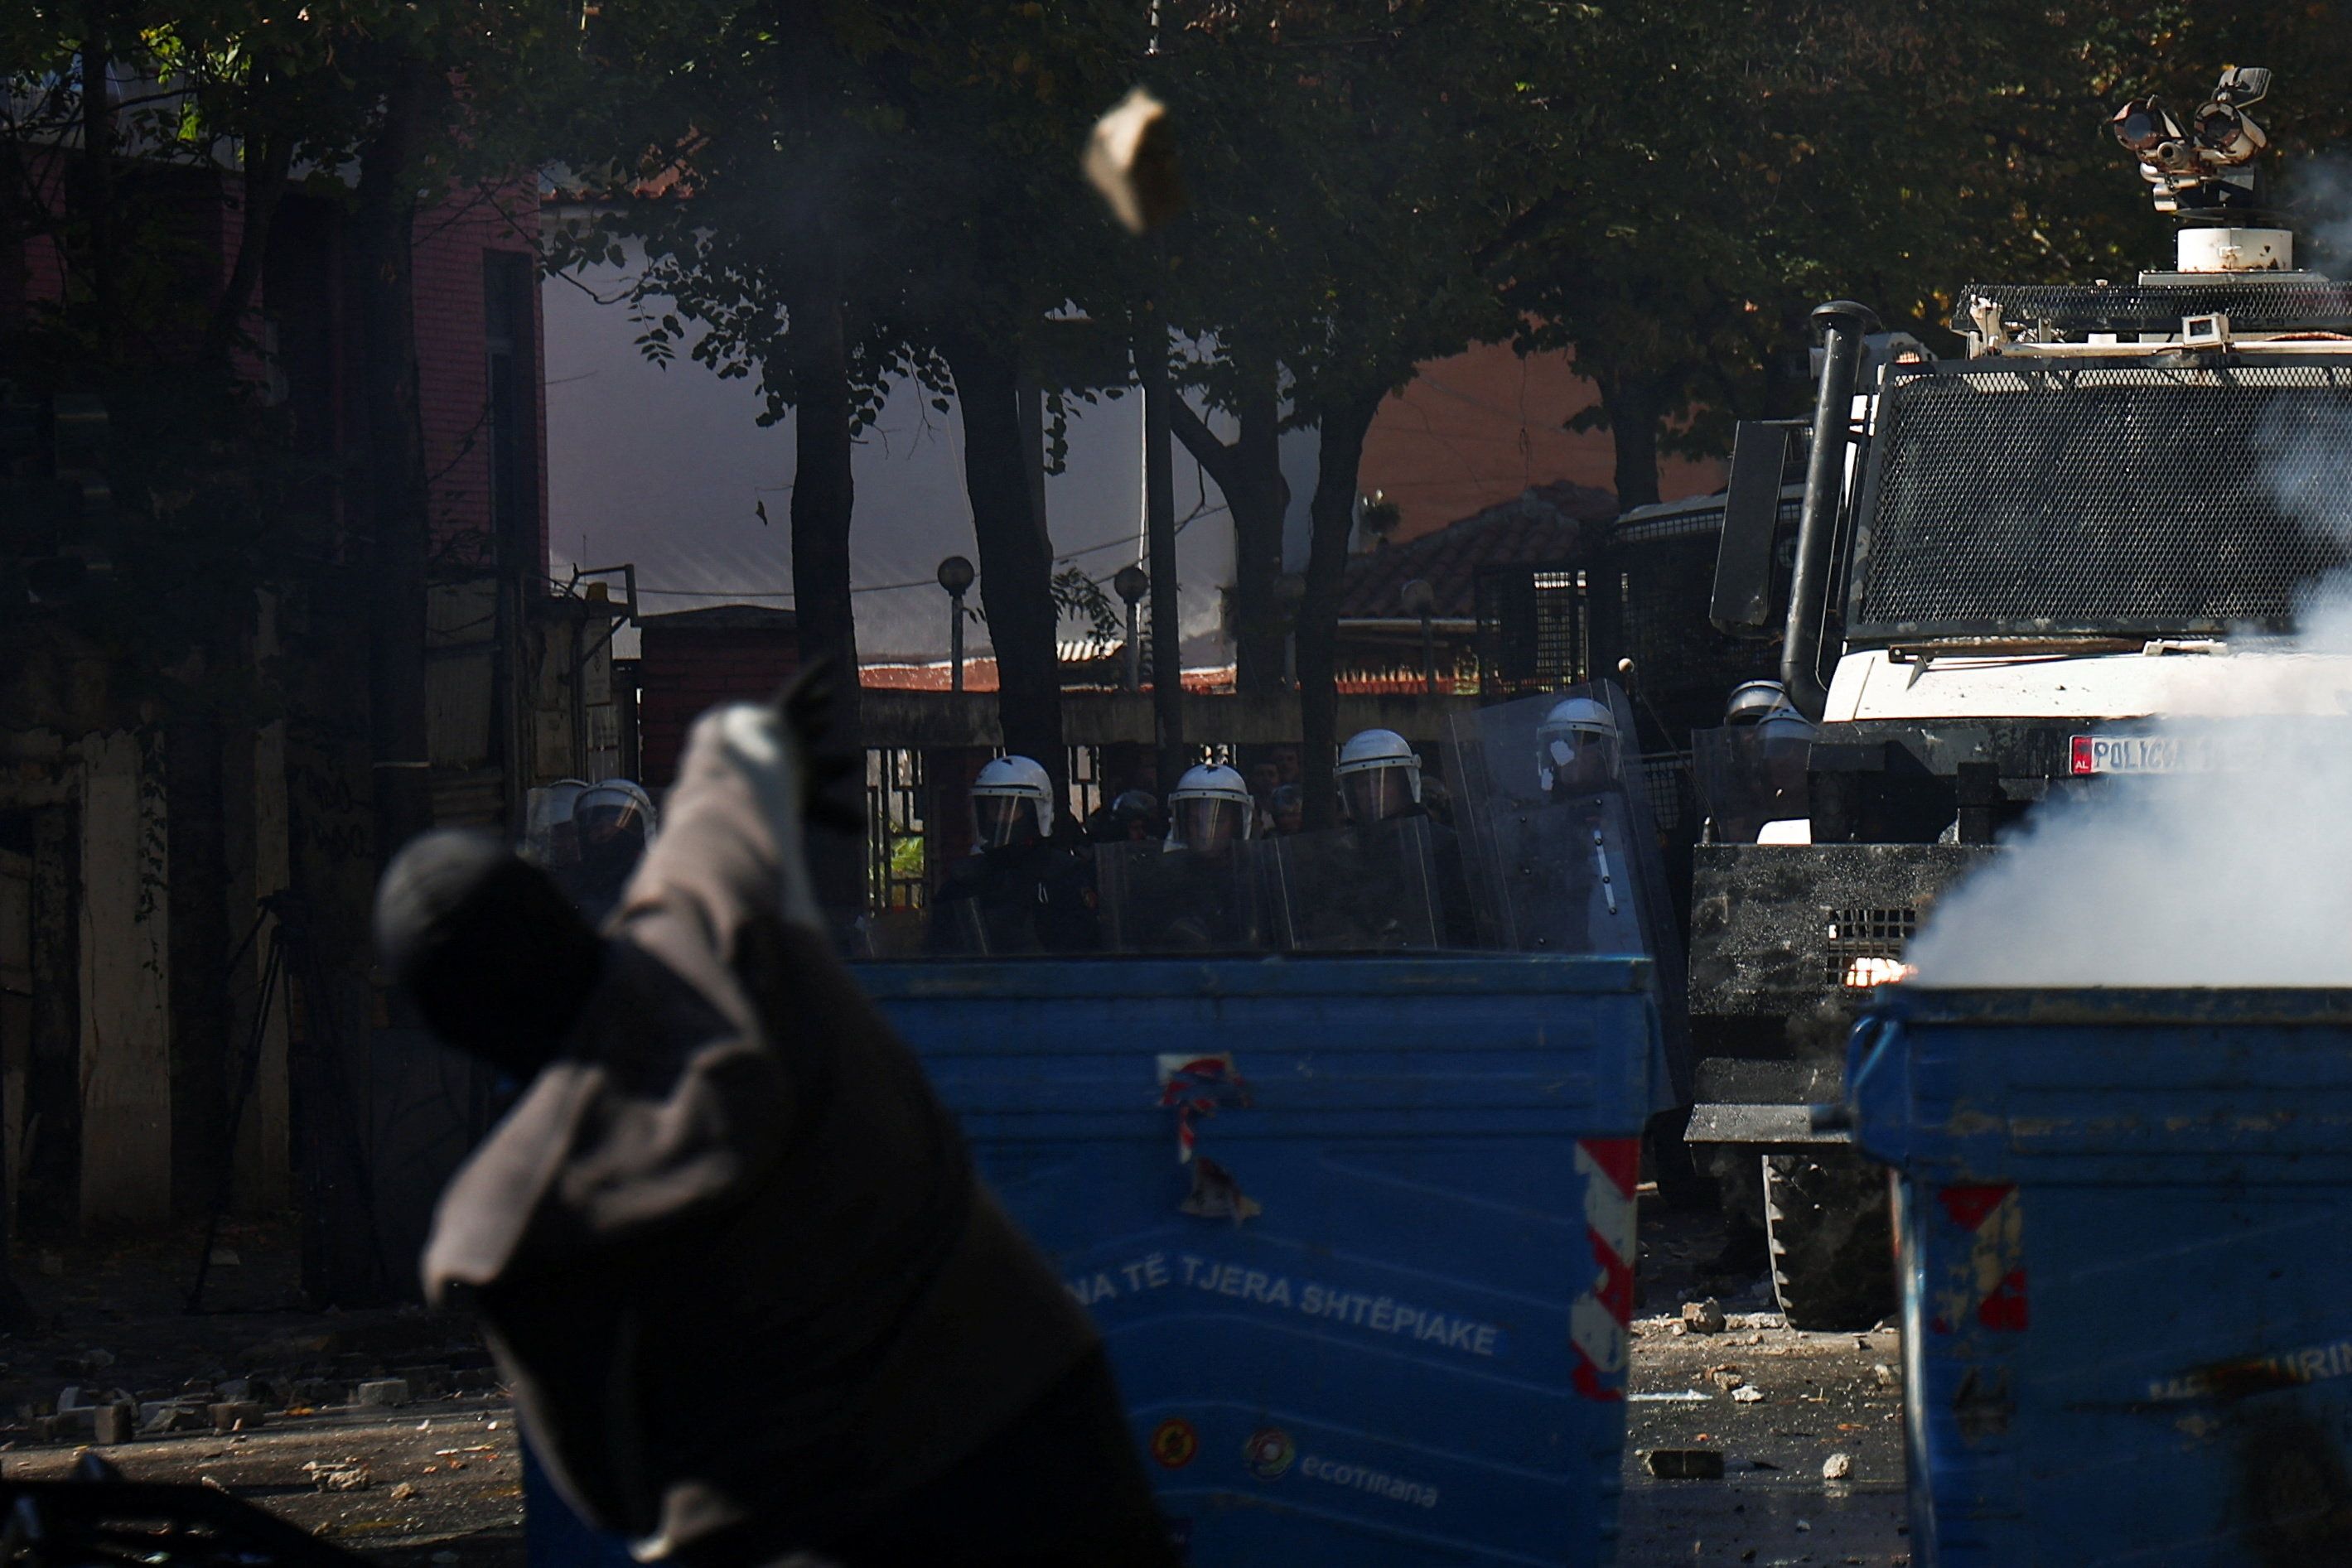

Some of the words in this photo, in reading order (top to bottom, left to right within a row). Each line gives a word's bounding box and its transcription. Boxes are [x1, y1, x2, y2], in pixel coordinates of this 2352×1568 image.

[2075, 760, 2089, 770] AL
[1121, 1253, 1170, 1291] TË
[1182, 1255, 1291, 1308] TJERA
[1300, 1284, 1500, 1357] SHTËPIAKE
